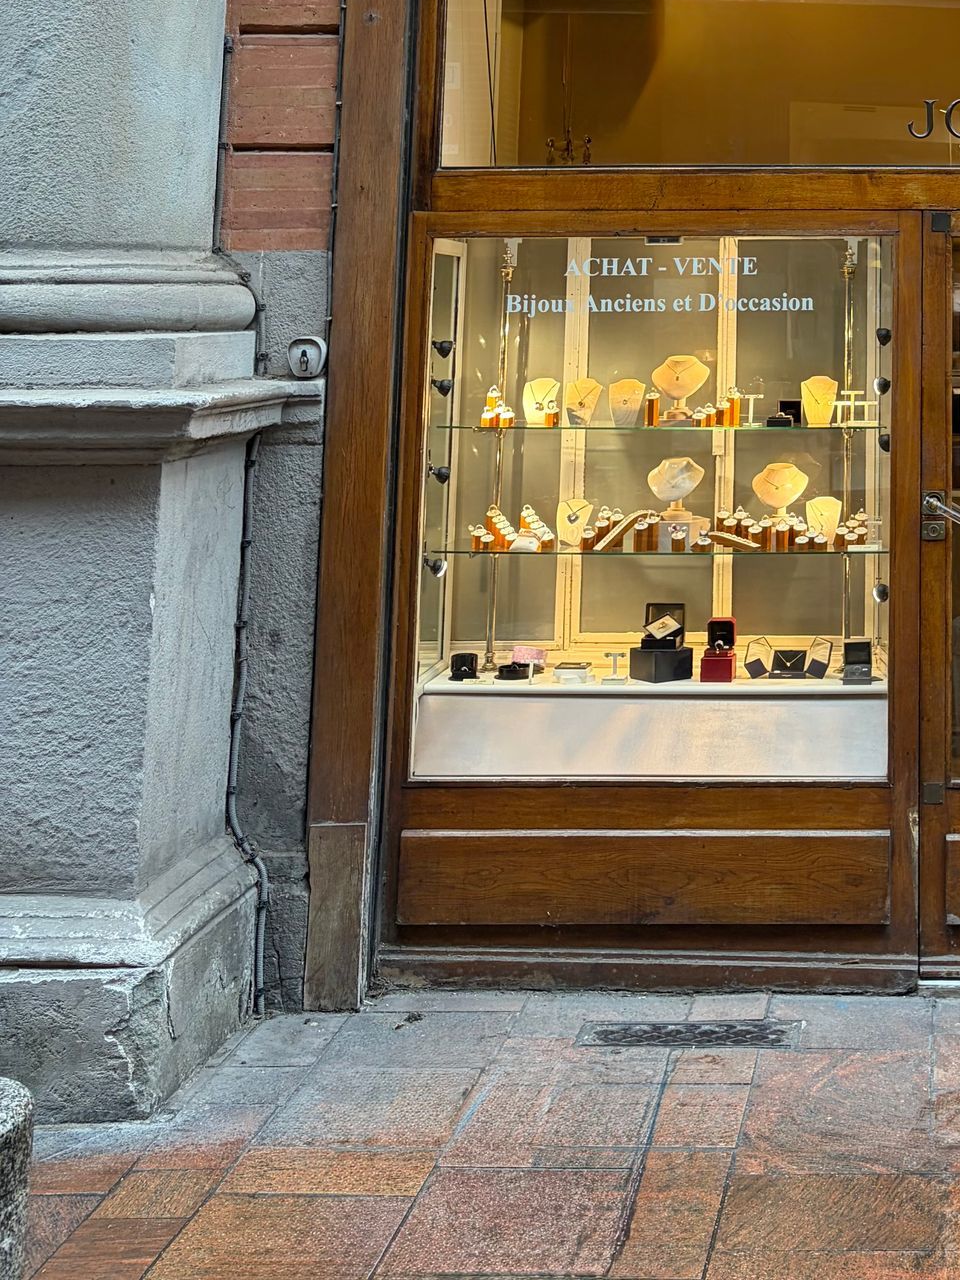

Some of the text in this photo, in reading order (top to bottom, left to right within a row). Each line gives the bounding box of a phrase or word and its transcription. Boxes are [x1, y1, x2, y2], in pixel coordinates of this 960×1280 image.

[564, 257, 653, 277] ACHAT
[673, 256, 758, 276] VENTE
[585, 294, 665, 313] Anciens
[673, 296, 693, 313] et
[698, 293, 814, 312] D'occasion
